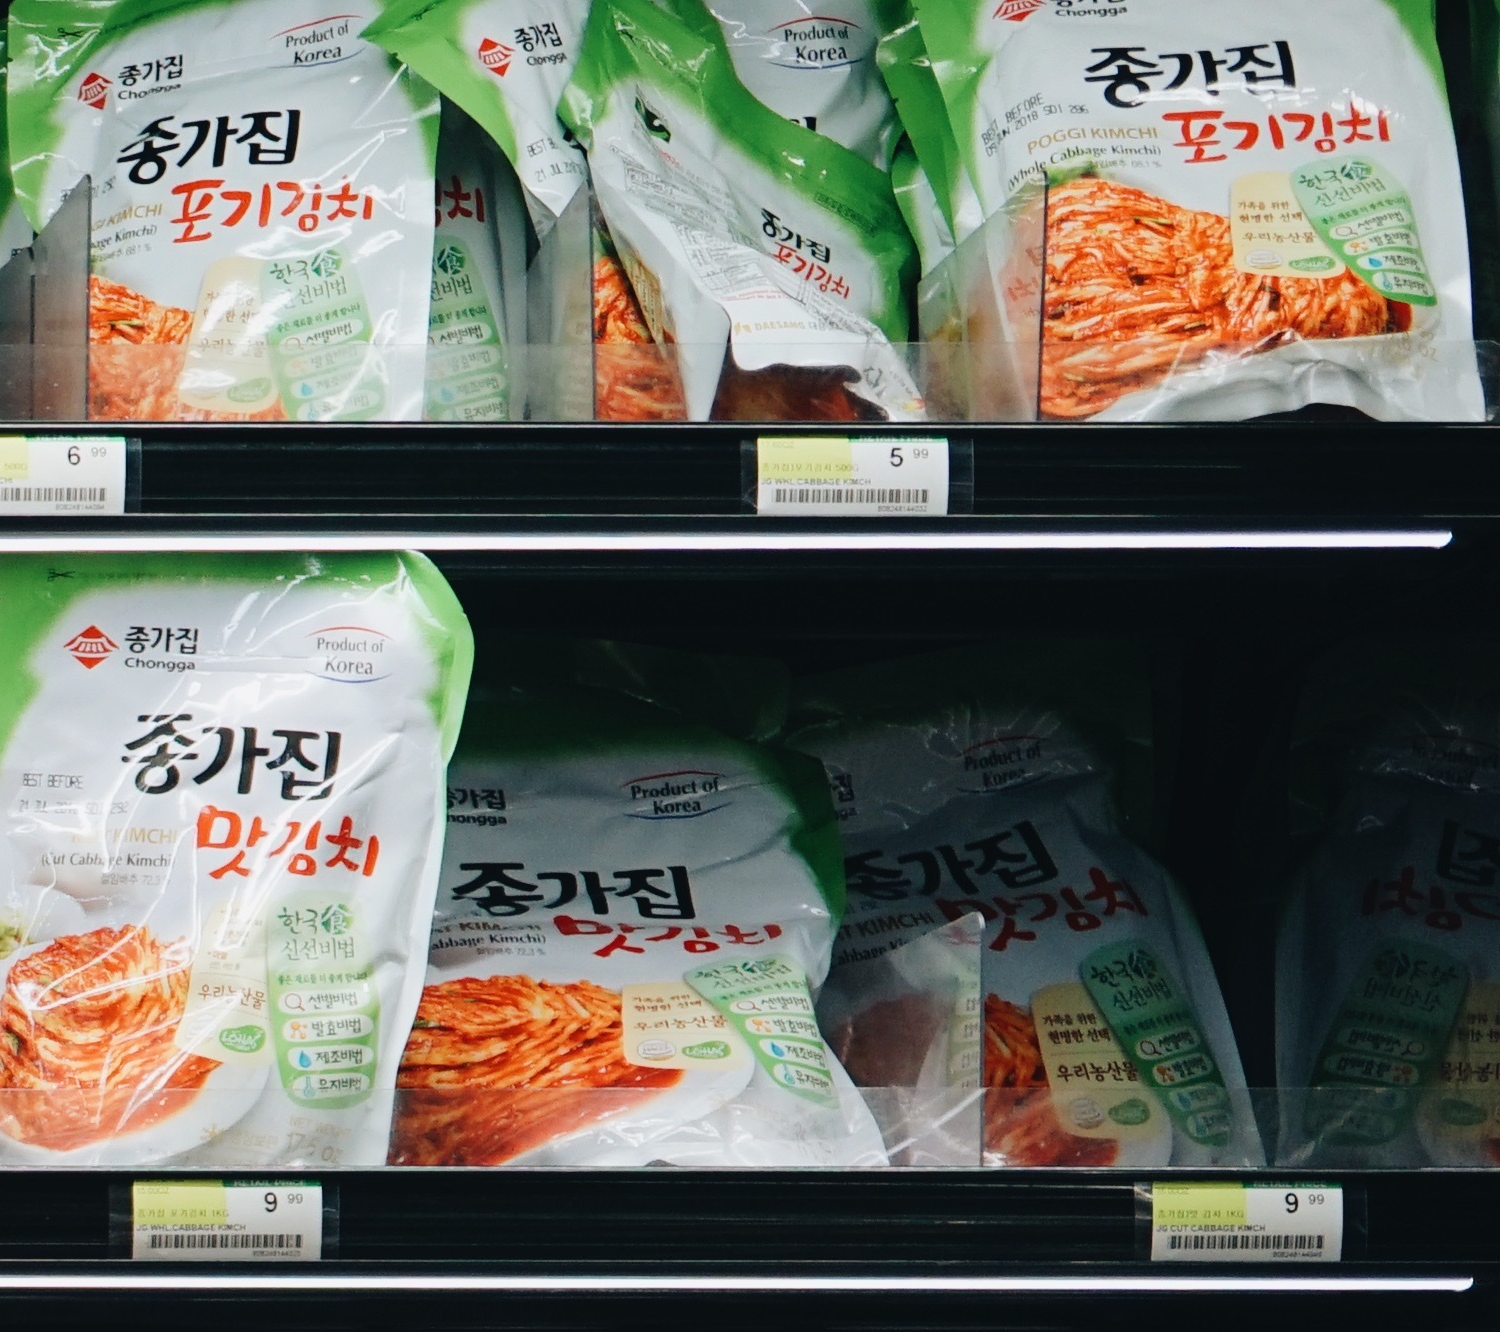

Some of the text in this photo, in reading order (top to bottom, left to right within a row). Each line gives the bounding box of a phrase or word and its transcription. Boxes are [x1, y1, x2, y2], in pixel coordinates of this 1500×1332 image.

[1055, 5, 1128, 20] Chongga
[514, 20, 564, 53] 종가집
[118, 53, 184, 88] 종가집
[1083, 40, 1297, 110] 종가집
[116, 108, 302, 185] 종가집
[1027, 125, 1158, 156] POGGI KIMCHI
[1163, 108, 1391, 165] 포기김치
[168, 178, 375, 244] 포기김치
[66, 446, 107, 466] 6 99
[889, 446, 929, 467] 5 99
[123, 624, 199, 657] 종가집
[123, 656, 197, 671] Chongga
[325, 656, 373, 678] Korea
[122, 713, 342, 801] 종가집
[195, 803, 380, 879] 맛김치
[449, 861, 698, 923] 종가집
[553, 913, 782, 959] 맛김치
[262, 1191, 304, 1213] 9 99
[1284, 1191, 1325, 1215] 9 99
